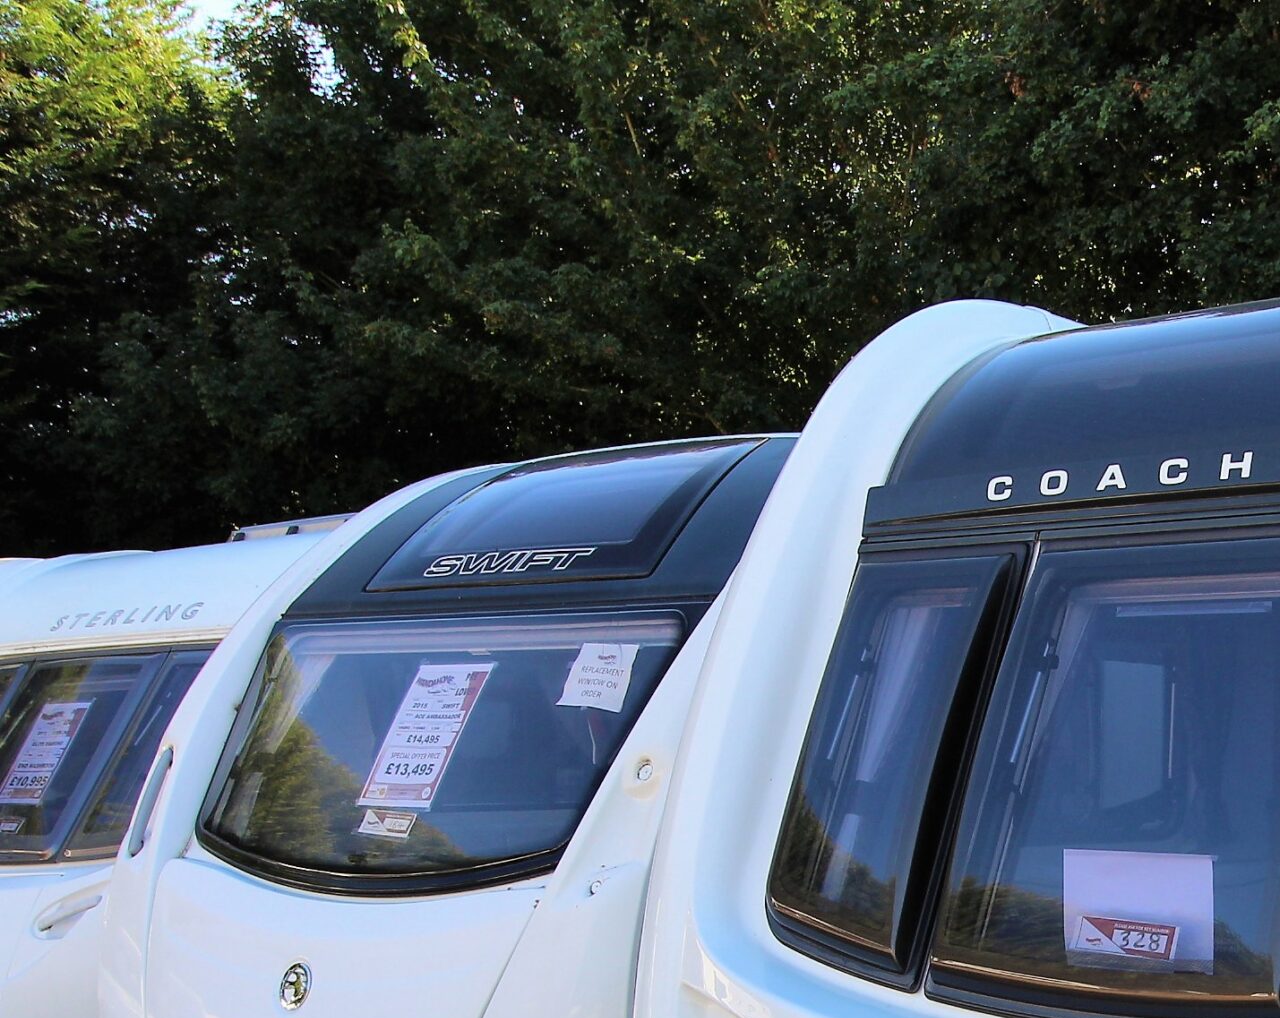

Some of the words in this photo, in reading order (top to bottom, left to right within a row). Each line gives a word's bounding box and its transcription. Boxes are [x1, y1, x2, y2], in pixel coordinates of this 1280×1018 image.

[424, 547, 598, 577] SWIFT
[50, 602, 205, 632] STERLING
[406, 734, 440, 745] £14,495
[384, 763, 435, 778] £13,495
[9, 776, 49, 788] £10,995
[1120, 930, 1160, 951] 328
